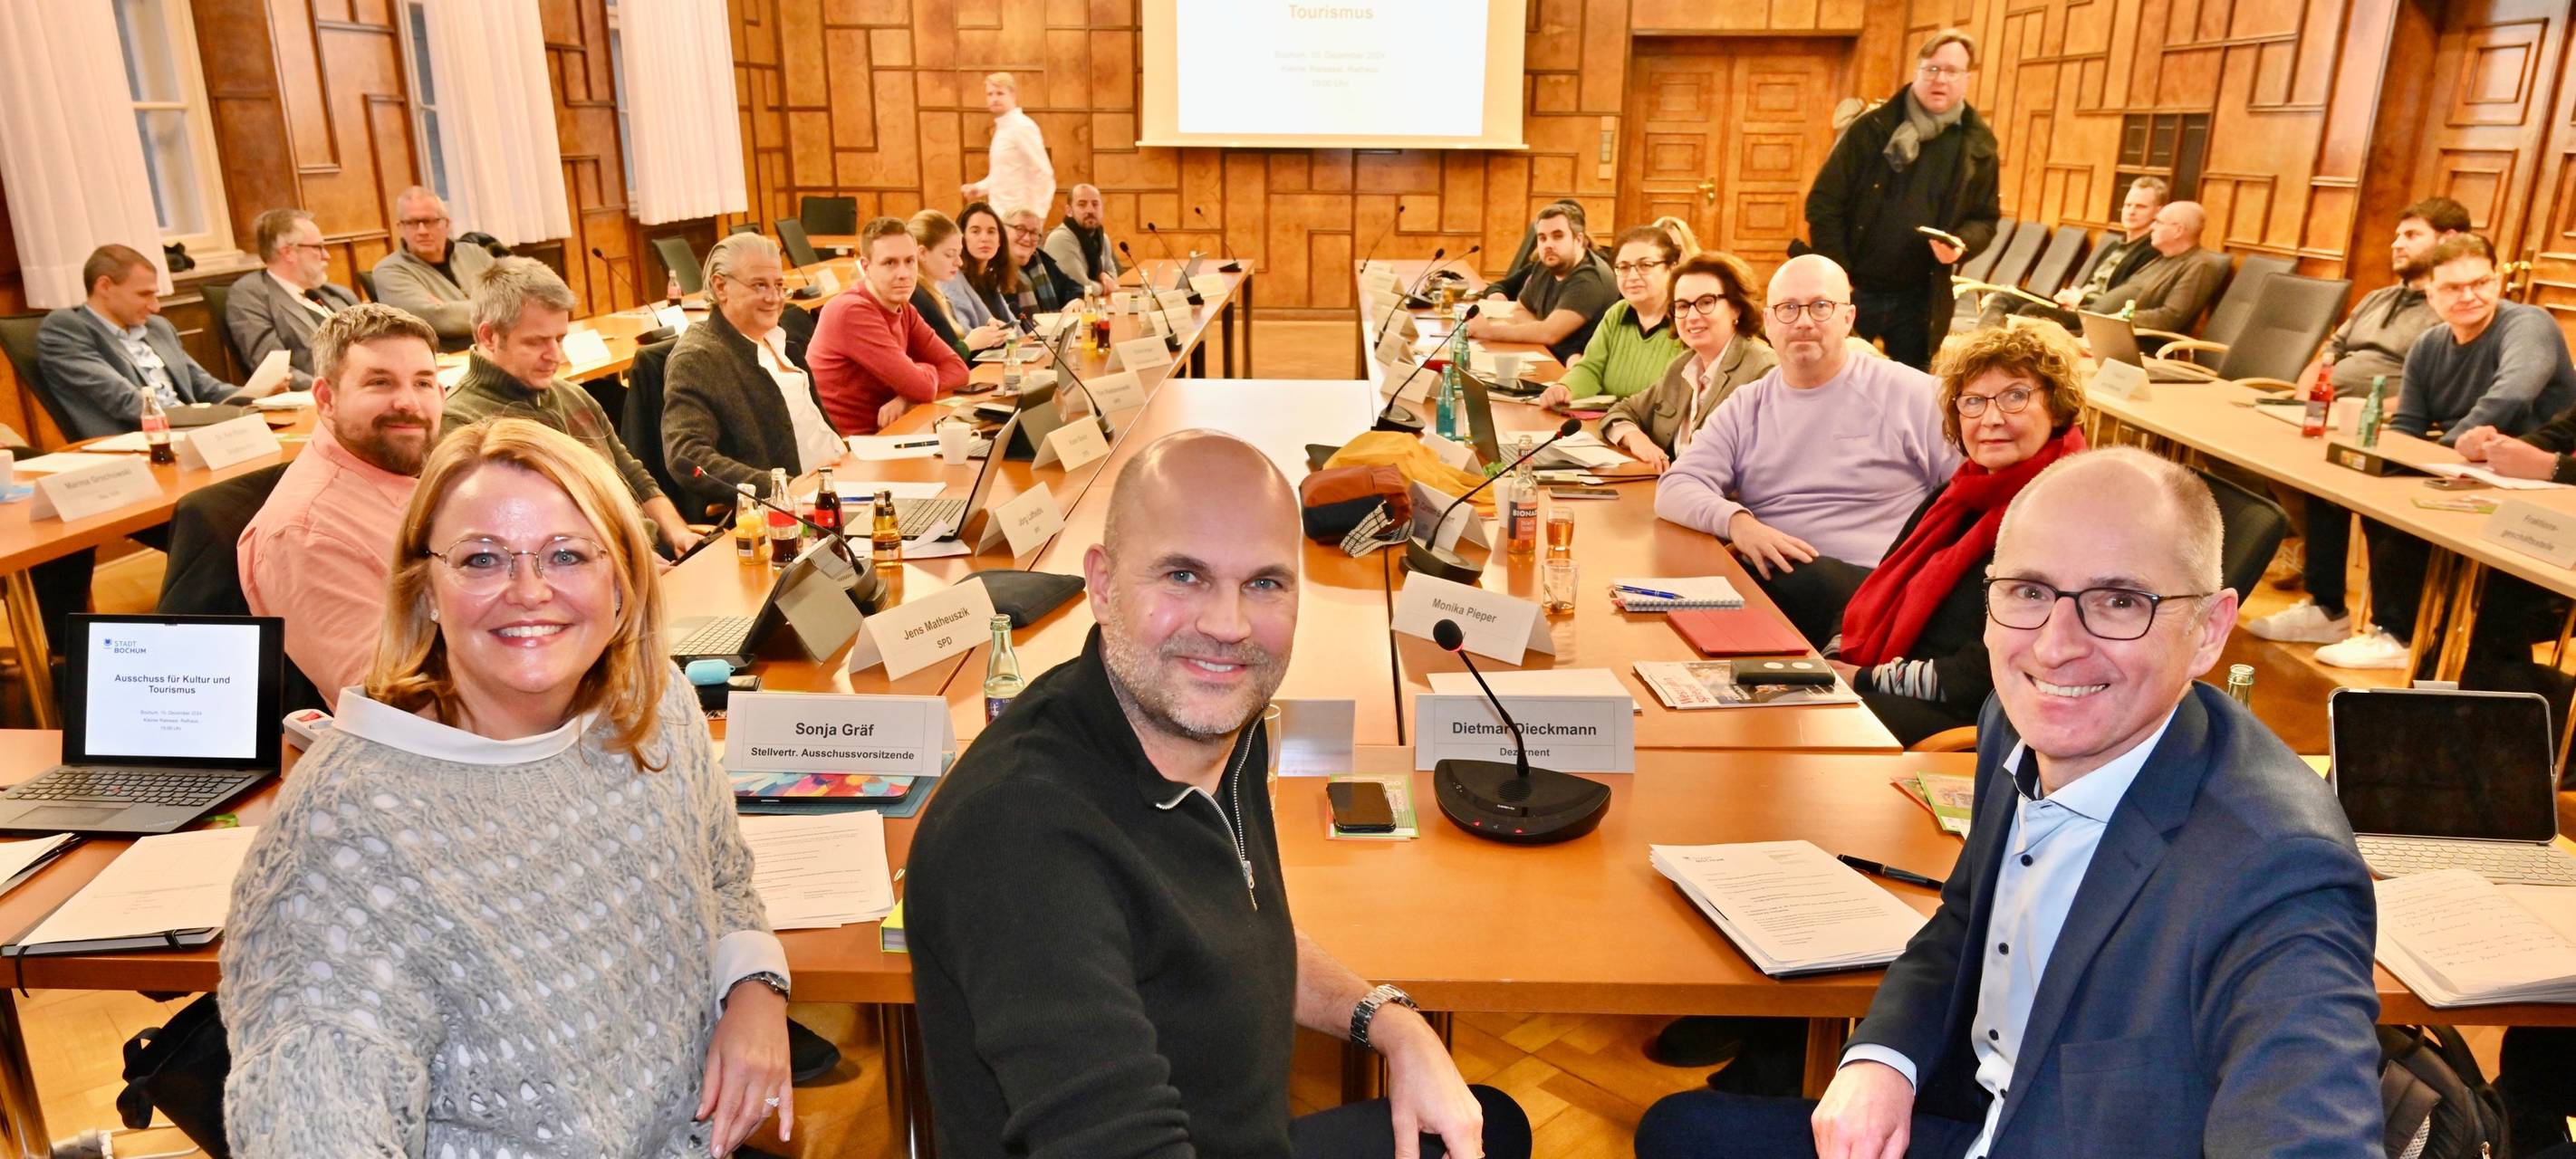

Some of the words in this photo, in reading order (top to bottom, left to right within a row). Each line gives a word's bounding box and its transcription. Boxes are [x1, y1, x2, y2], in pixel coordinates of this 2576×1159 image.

[1288, 5, 1374, 19] Tourismus
[1432, 598, 1465, 615] Monika
[1466, 607, 1497, 623] Pieper
[904, 626, 924, 640] Jens
[924, 608, 970, 632] Matheuszik
[937, 636, 952, 648] SPD
[114, 674, 165, 683] Ausschuss
[168, 675, 180, 683] für
[182, 675, 210, 684] Kultur
[213, 675, 231, 685] und
[149, 685, 197, 694] Tourismus
[795, 723, 837, 738] Sonja
[841, 723, 874, 736] Gräf
[1452, 722, 1510, 734] Dietmar
[1515, 723, 1597, 735] Dieckmann
[751, 747, 798, 757] Stellvertr.
[802, 749, 915, 760] Ausschussvorsitzende
[1500, 748, 1550, 757] Dezrnent
